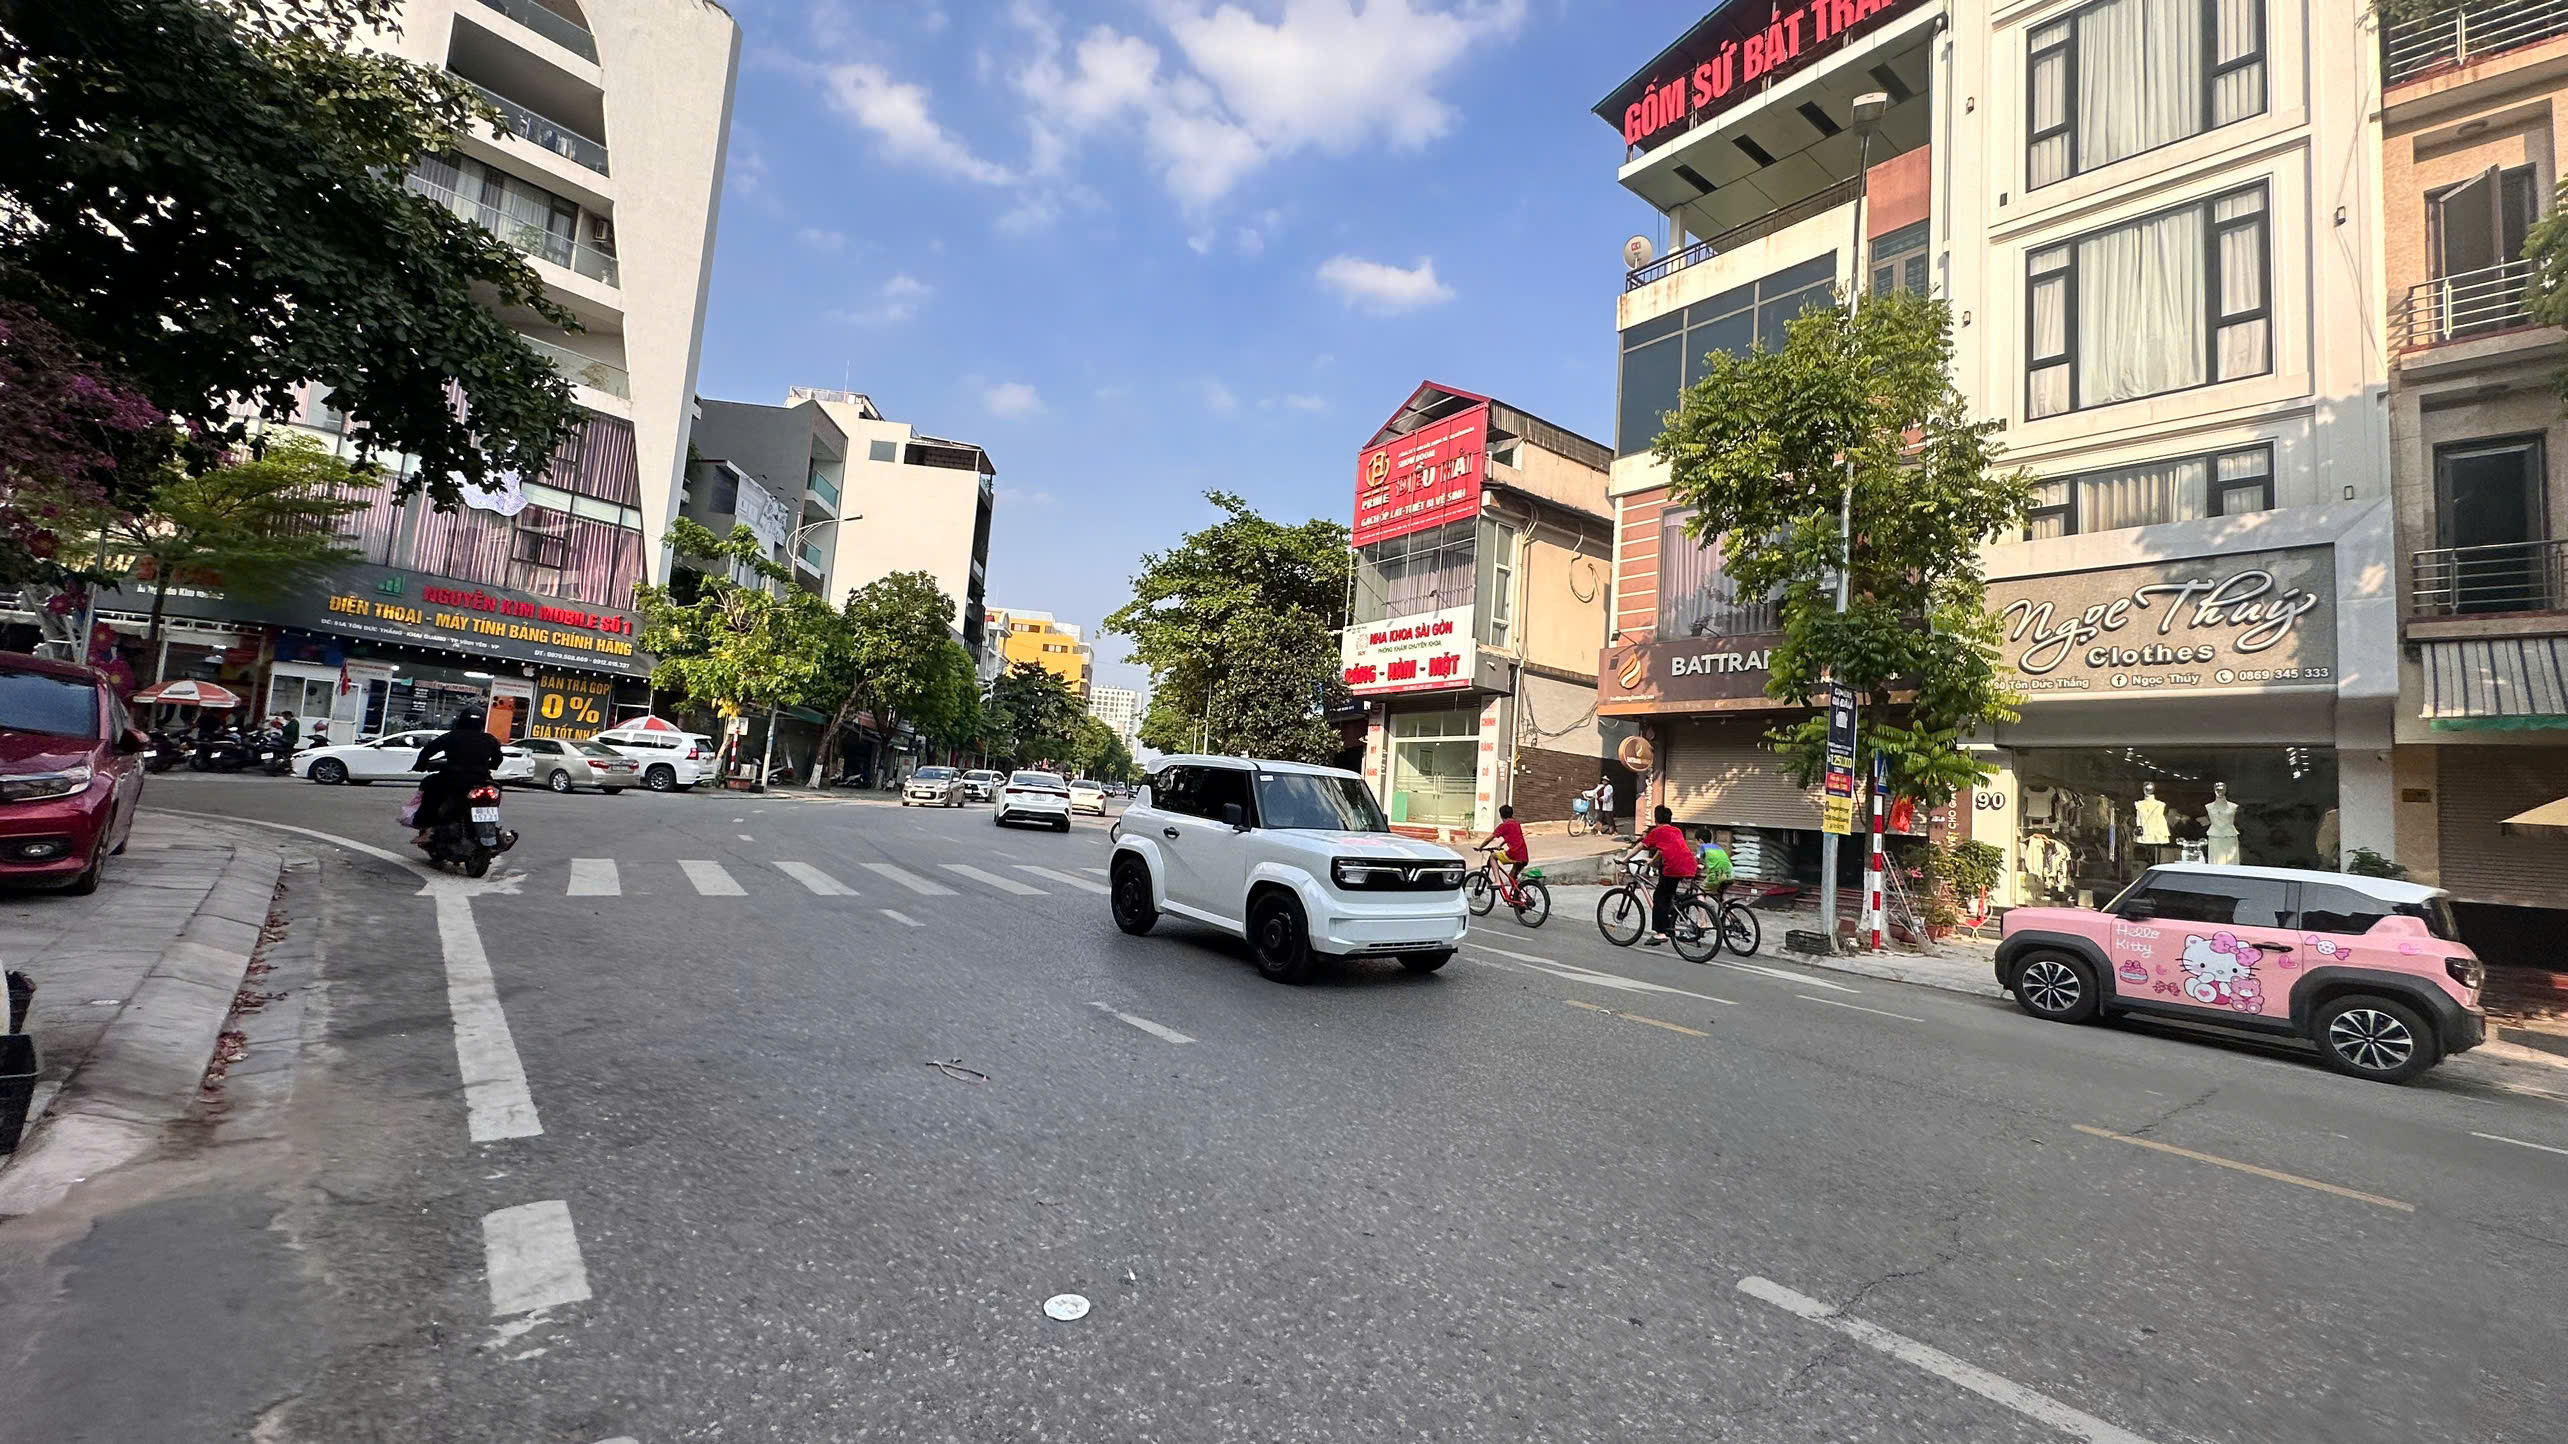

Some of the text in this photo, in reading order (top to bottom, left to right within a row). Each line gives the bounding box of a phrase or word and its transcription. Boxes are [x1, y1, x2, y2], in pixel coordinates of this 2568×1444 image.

[1624, 75, 1686, 146] GỐM
[1693, 40, 1738, 109] SỨ
[1743, 10, 1805, 83] BÁT
[329, 592, 633, 657] ĐIỆN THOẠI MÁY TÍNH BẢNG CHÍNH HÃNG
[500, 597, 536, 618] KIM
[538, 605, 601, 630] MOBILE
[600, 615, 623, 634] SỐ
[623, 621, 633, 636] 1
[1369, 618, 1454, 646] NHA KHOA SÀI GÒN
[2004, 597, 2134, 675] Ngọc
[1428, 651, 1461, 680] MẶT
[2087, 644, 2215, 667] Clothes
[566, 676, 588, 693] TRẢ
[2009, 679, 2028, 689] Tôn
[2031, 678, 2054, 689] Đức
[2056, 675, 2090, 690] Thắng
[2132, 675, 2164, 687] Ngọc
[2238, 666, 2329, 682] 0869 345 333
[540, 693, 565, 720] 0
[532, 723, 601, 741] GIÁ TỐT NHẤ
[1975, 791, 2006, 811] 90
[1947, 810, 1958, 830] CHO
[2115, 923, 2161, 939] Hello
[2115, 938, 2153, 959] Kitty
